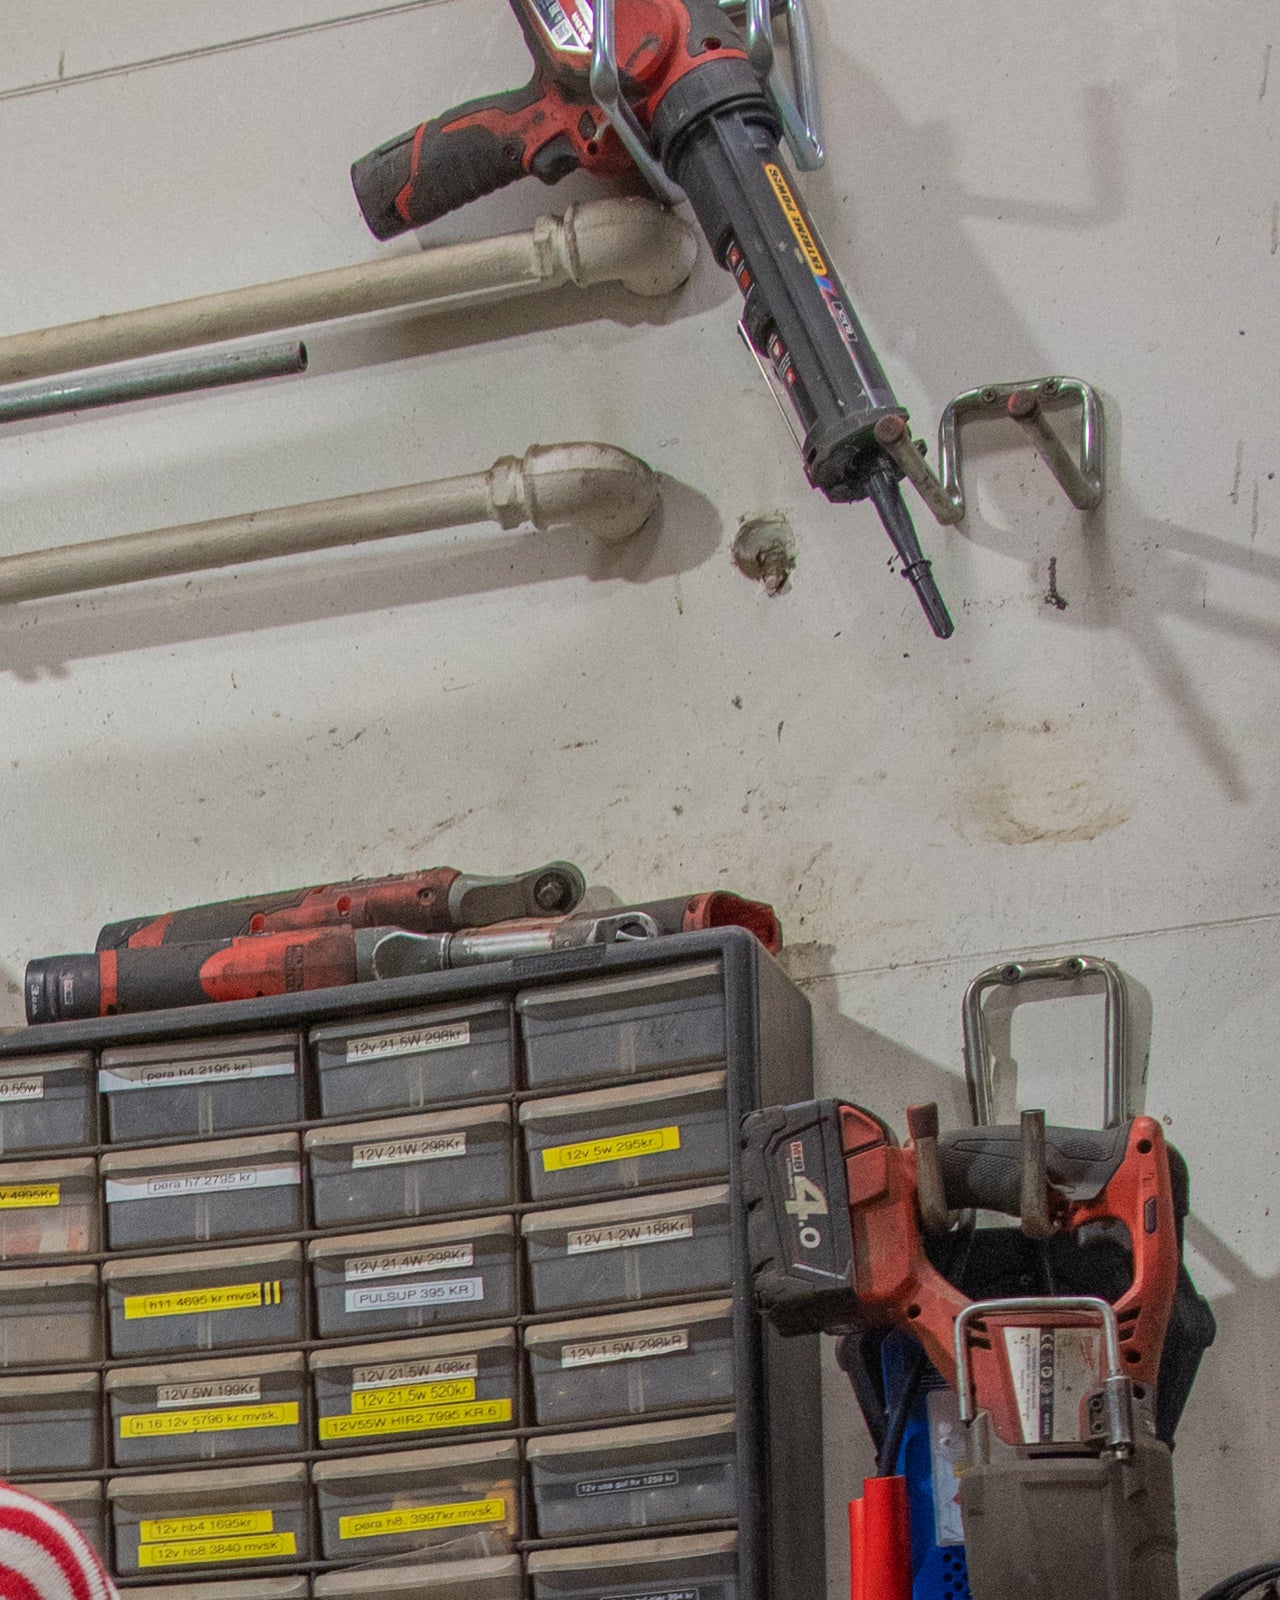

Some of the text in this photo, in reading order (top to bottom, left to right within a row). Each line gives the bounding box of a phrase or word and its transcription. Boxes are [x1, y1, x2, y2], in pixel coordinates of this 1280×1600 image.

[792, 215, 823, 272] EXTREME
[234, 1063, 248, 1071] kr
[359, 1149, 383, 1162] 12V
[387, 1143, 418, 1158] 21W
[566, 1150, 589, 1161] 12v
[153, 1179, 181, 1191] pera
[239, 1171, 252, 1182] kr
[784, 1175, 829, 1250] 4.0
[576, 1234, 602, 1247] 12V
[353, 1260, 378, 1274] 12V
[211, 1293, 223, 1303] kr
[359, 1285, 469, 1304] PULSUP 395 KR
[570, 1348, 596, 1361] 12V
[361, 1368, 386, 1383] 12V
[165, 1388, 187, 1400] 12V
[191, 1386, 213, 1398] 5W
[361, 1393, 385, 1407] 12v
[430, 1384, 468, 1399] 520kr
[168, 1416, 188, 1427] 12v
[227, 1412, 239, 1423] kr
[155, 1524, 177, 1535] 12v
[157, 1548, 180, 1559] 12v
